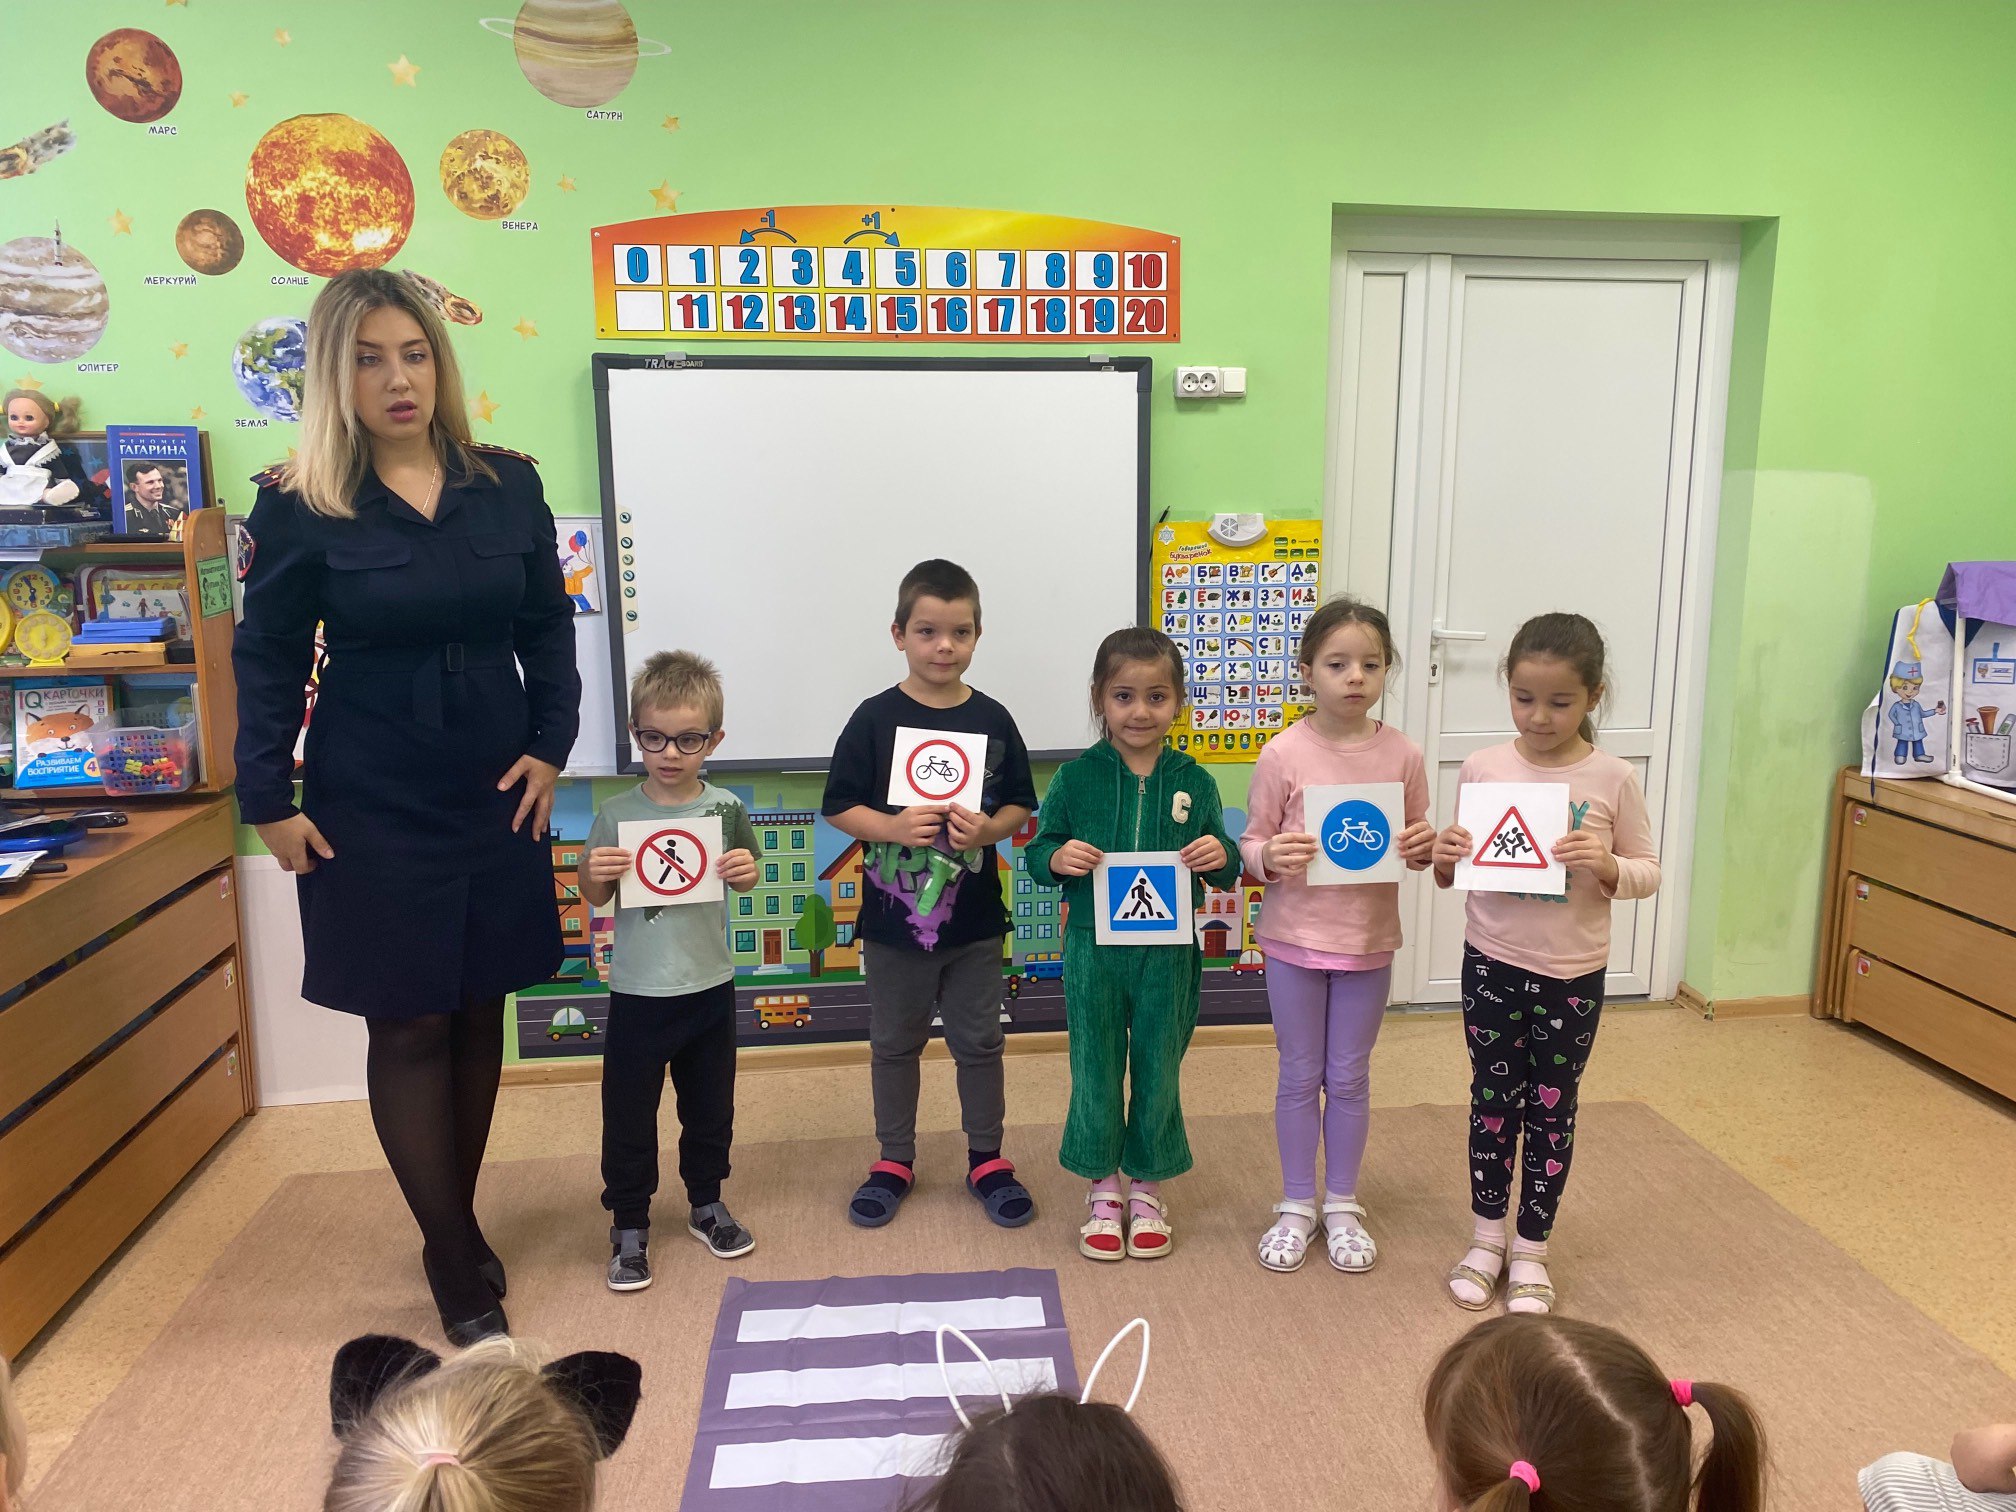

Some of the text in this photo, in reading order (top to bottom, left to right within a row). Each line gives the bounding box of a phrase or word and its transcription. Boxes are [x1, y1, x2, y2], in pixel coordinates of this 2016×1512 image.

[586, 110, 623, 120] САТУРН
[148, 125, 178, 135] МАРС
[760, 209, 775, 228] -1
[861, 211, 881, 229] +1
[502, 221, 539, 231] ВЕНЕРА
[626, 247, 1163, 289] 0 1 2 3 4 5 6 7 8 9 10
[143, 275, 197, 285] МЕРКУРИЙ
[271, 276, 310, 286] СОЛНЦЕ
[677, 294, 1165, 333] 11 12 13 14 15 16 17 18 19 20
[77, 364, 120, 373] ЮПИТЕР
[234, 419, 269, 428] ЗЕМЛЯ
[119, 444, 188, 455] ГАГАРИНА
[1165, 563, 1304, 578] А Б В Г Д
[1166, 587, 1302, 603] Е Ё Ж З И
[1165, 613, 1301, 627] Й К Л М Н
[1196, 638, 1205, 651] П
[1227, 638, 1237, 649] Р
[1259, 637, 1269, 649] С
[1195, 663, 1208, 675] Ф
[1228, 662, 1237, 674] Х
[1258, 660, 1268, 674] Ц
[20, 690, 43, 709] IQ
[43, 687, 105, 700] КАРТОЧКИ
[1193, 686, 1207, 699] Щ
[1225, 686, 1238, 697] Ъ
[1257, 685, 1270, 696] Ы
[1195, 709, 1267, 722] Э Ю Я
[1227, 735, 1233, 743] 5
[1257, 734, 1263, 742] 7
[36, 757, 82, 768] РАЗВИВАЕМ
[86, 761, 97, 772] 4
[27, 765, 80, 776] ВОСПРИЯТИЕ
[1524, 979, 1541, 993] is
[1502, 1081, 1528, 1103] Love
[1470, 1146, 1499, 1160] Love
[1529, 1199, 1549, 1220] Love
